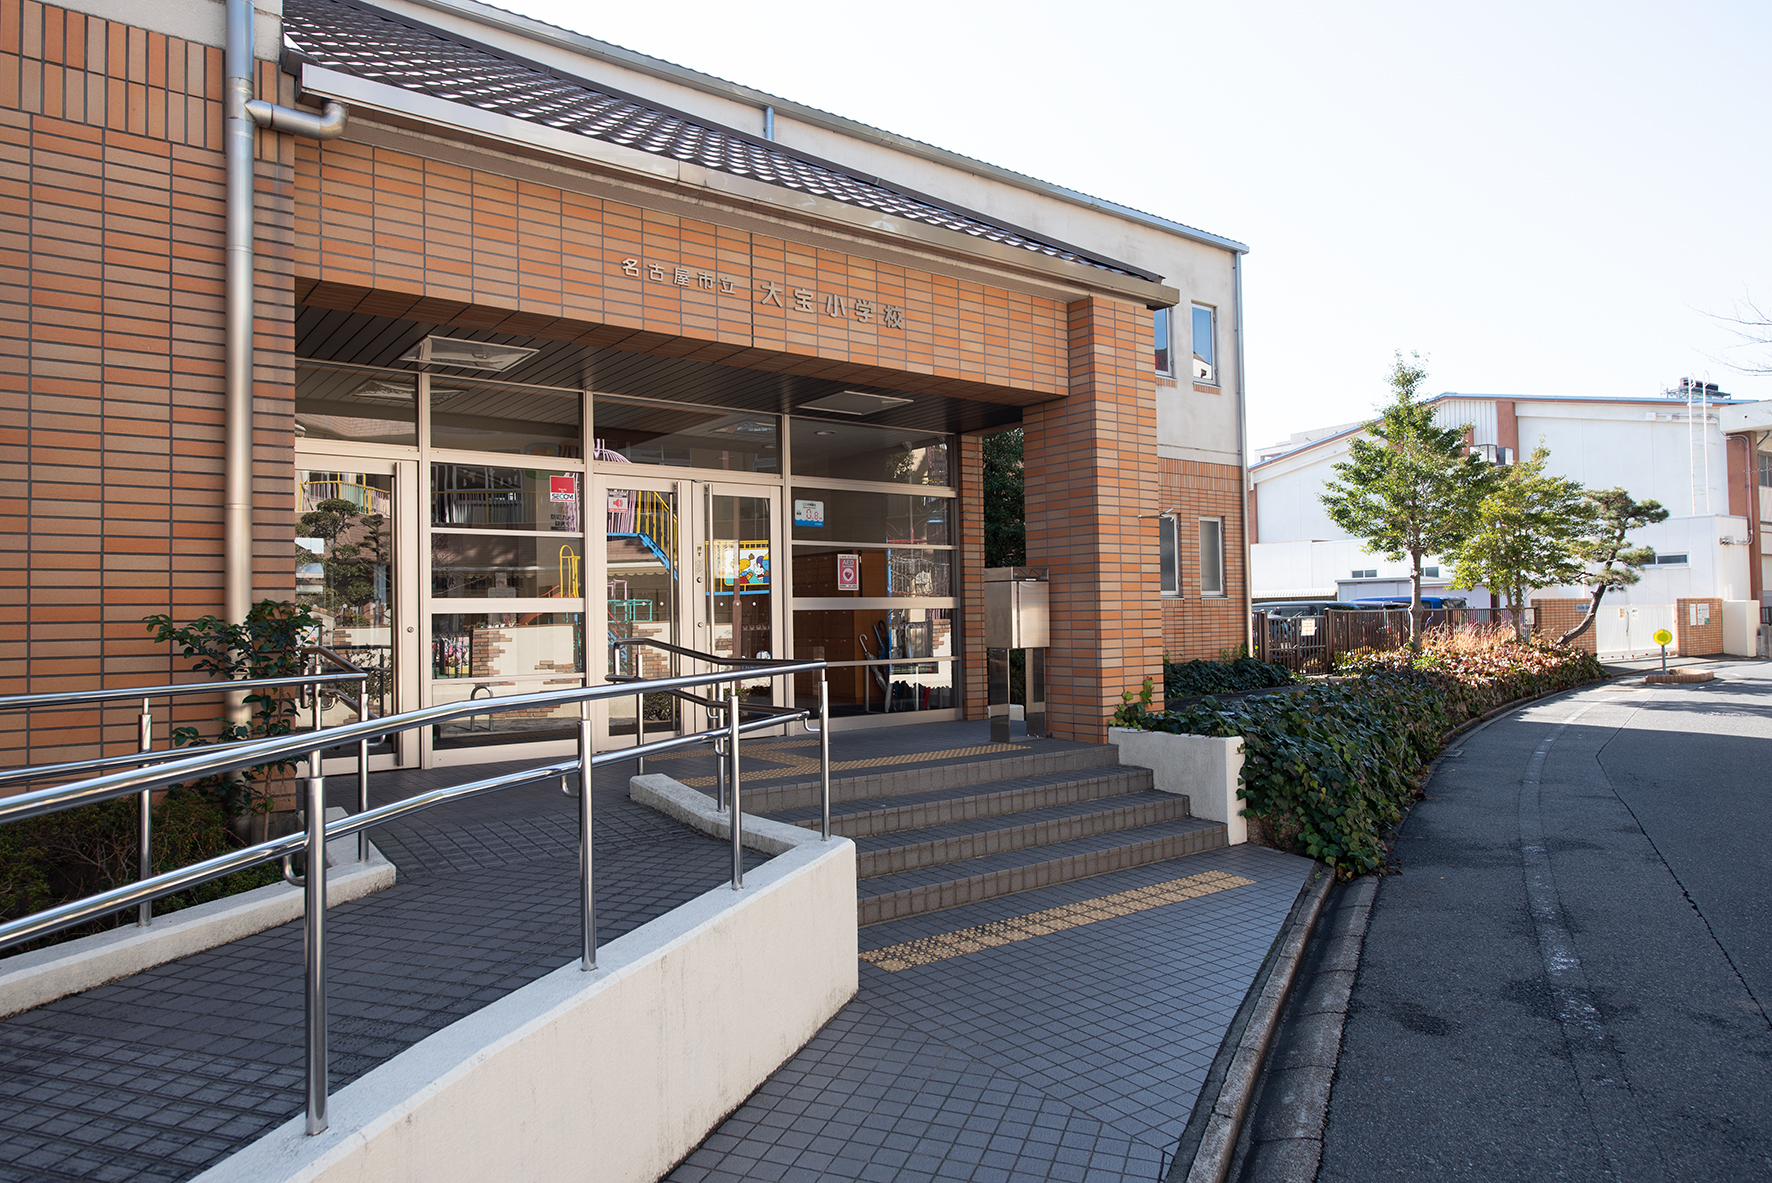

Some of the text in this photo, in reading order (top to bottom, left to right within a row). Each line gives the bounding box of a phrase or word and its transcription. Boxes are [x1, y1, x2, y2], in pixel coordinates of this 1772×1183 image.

[621, 258, 904, 330] 名古屋市立 大宝小学校
